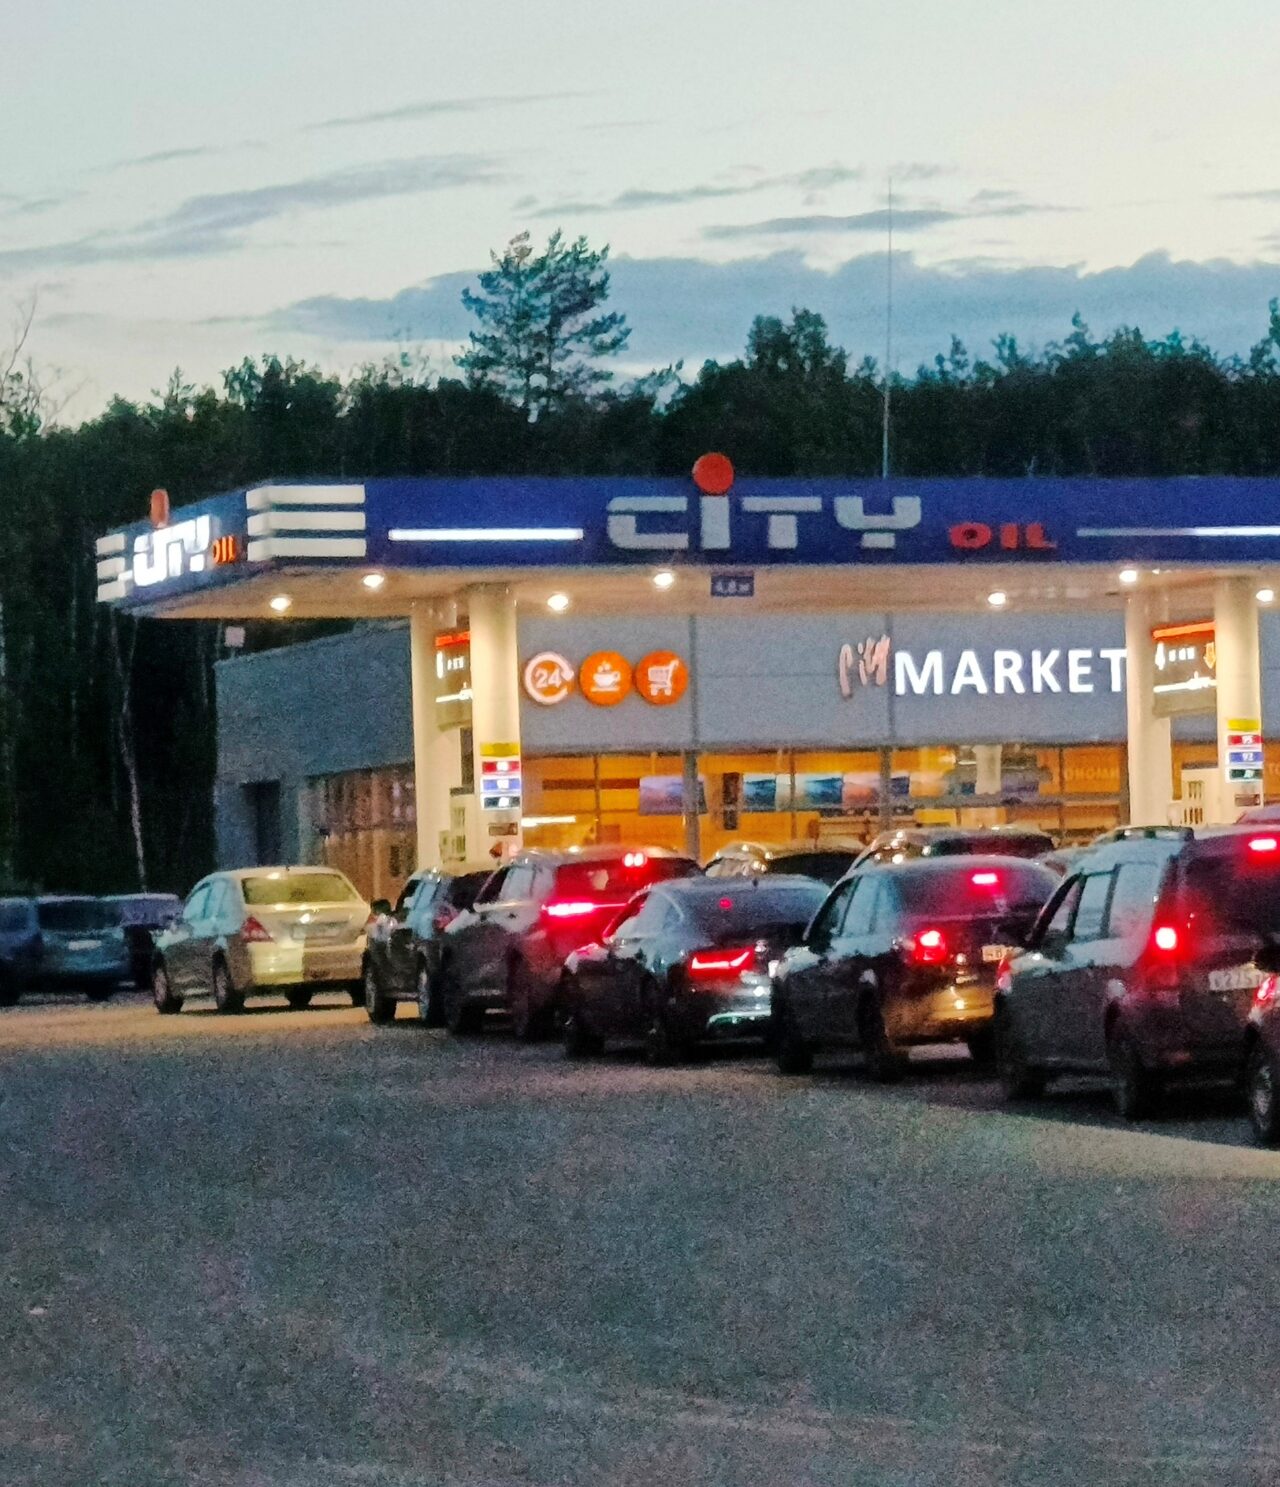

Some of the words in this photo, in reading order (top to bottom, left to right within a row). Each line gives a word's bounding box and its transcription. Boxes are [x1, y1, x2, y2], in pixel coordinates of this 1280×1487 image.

[949, 522, 1057, 549] OIL
[535, 667, 562, 689] 24
[895, 648, 1128, 697] MARKET
